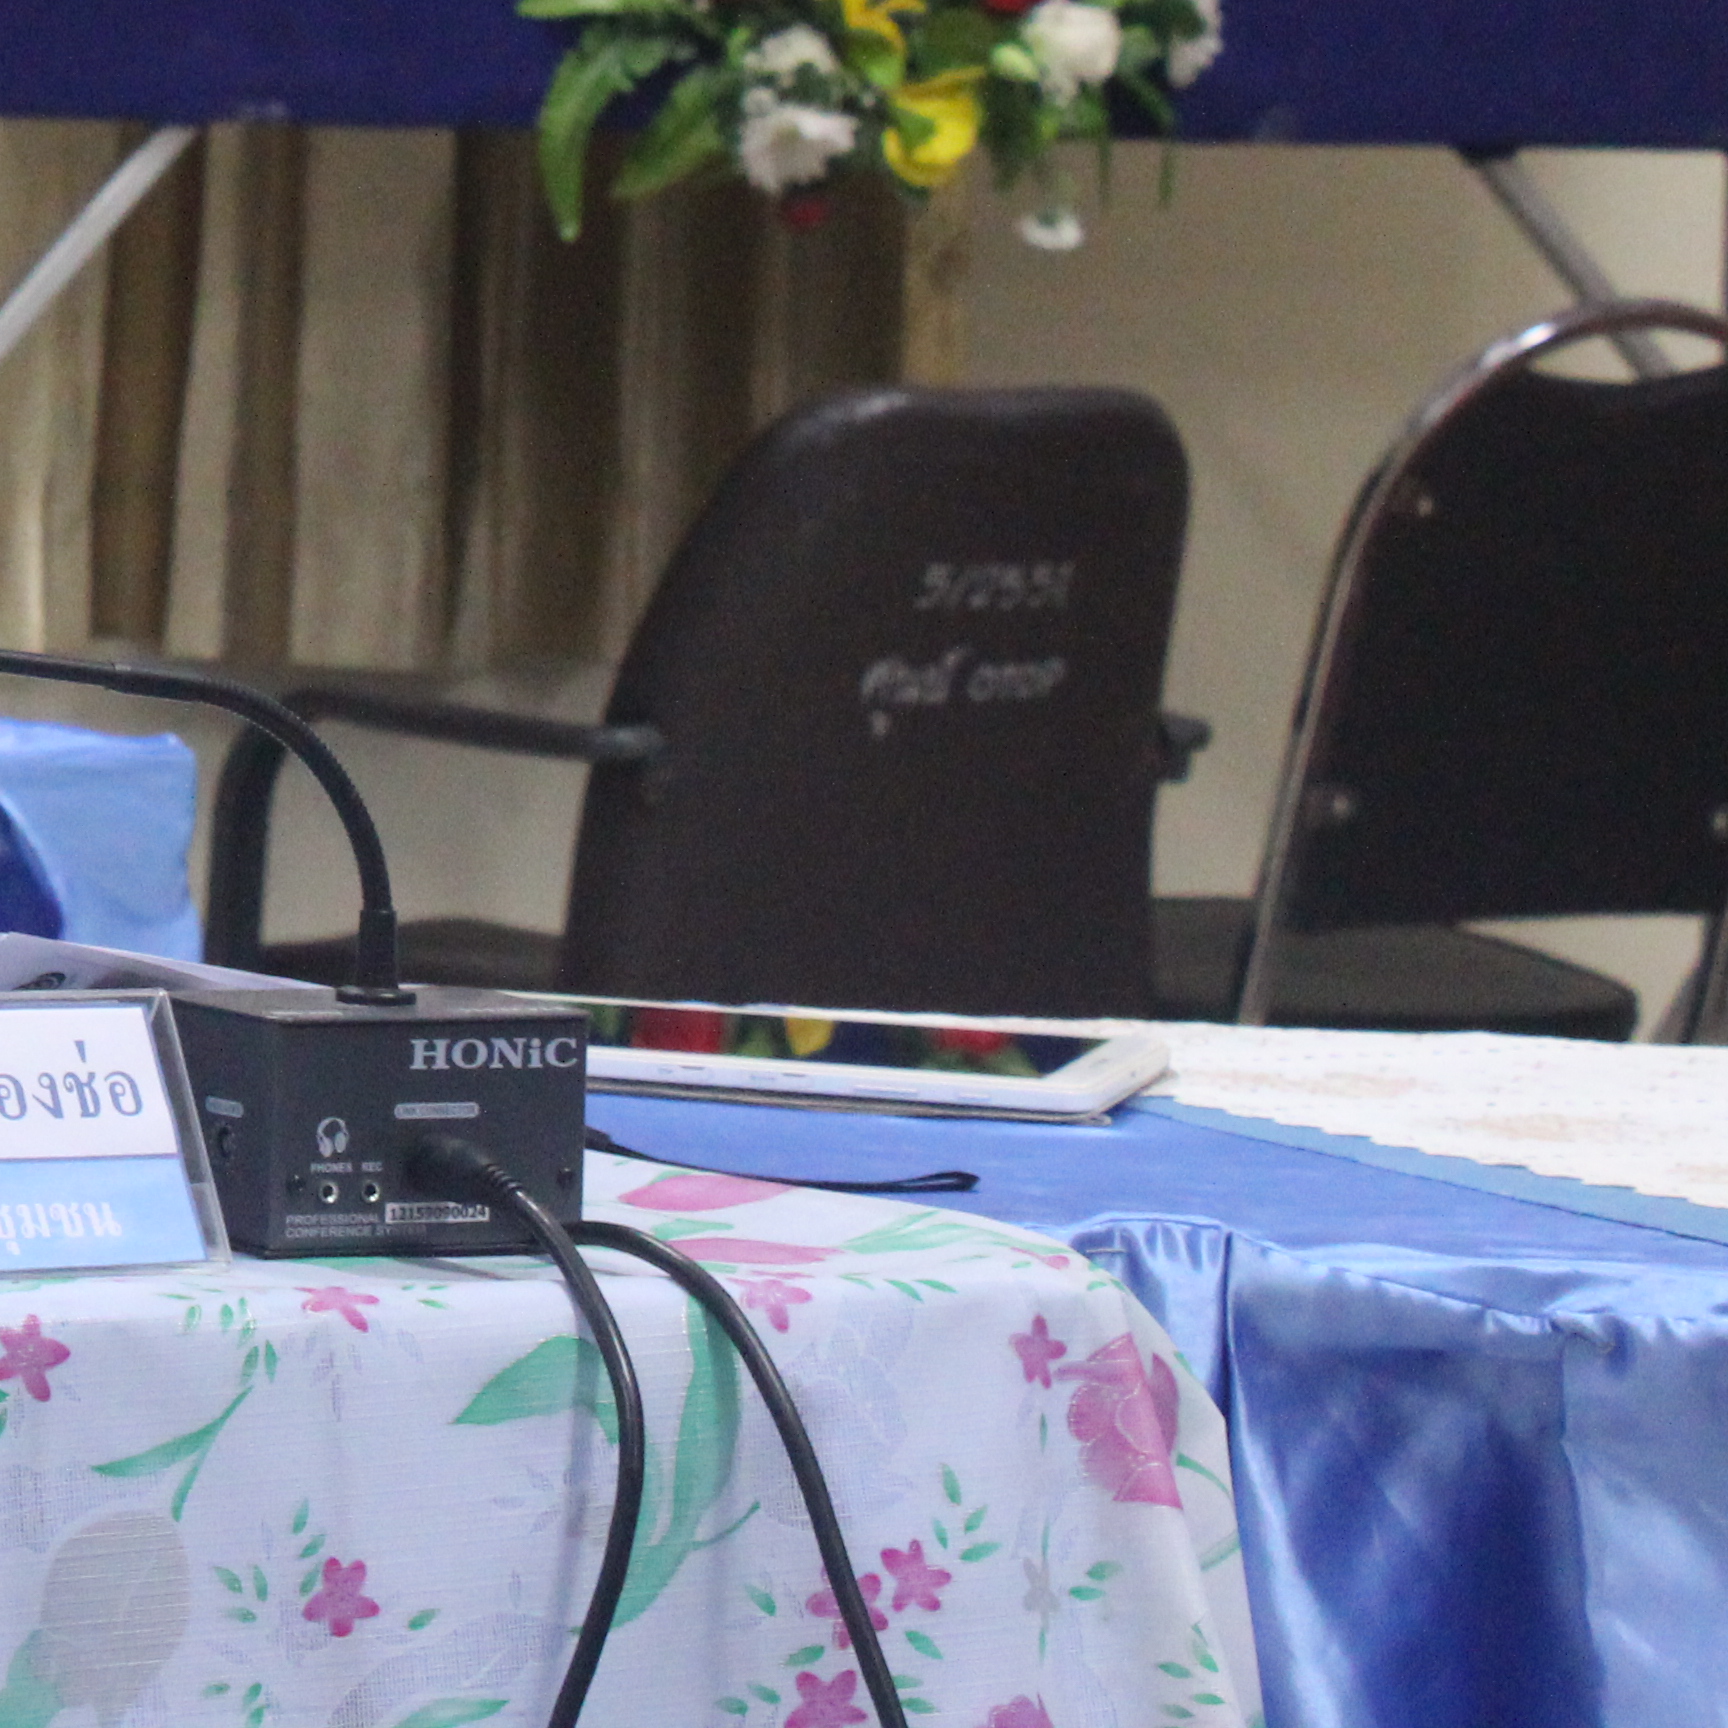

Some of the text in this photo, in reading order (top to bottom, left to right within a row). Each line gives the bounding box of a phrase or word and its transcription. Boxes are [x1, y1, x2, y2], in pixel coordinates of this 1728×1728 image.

[310, 1162, 353, 1173] PHONES
[361, 1161, 383, 1172] REC
[285, 1213, 379, 1225] PROFESSIONAL
[285, 1226, 372, 1238] CONFERENCE
